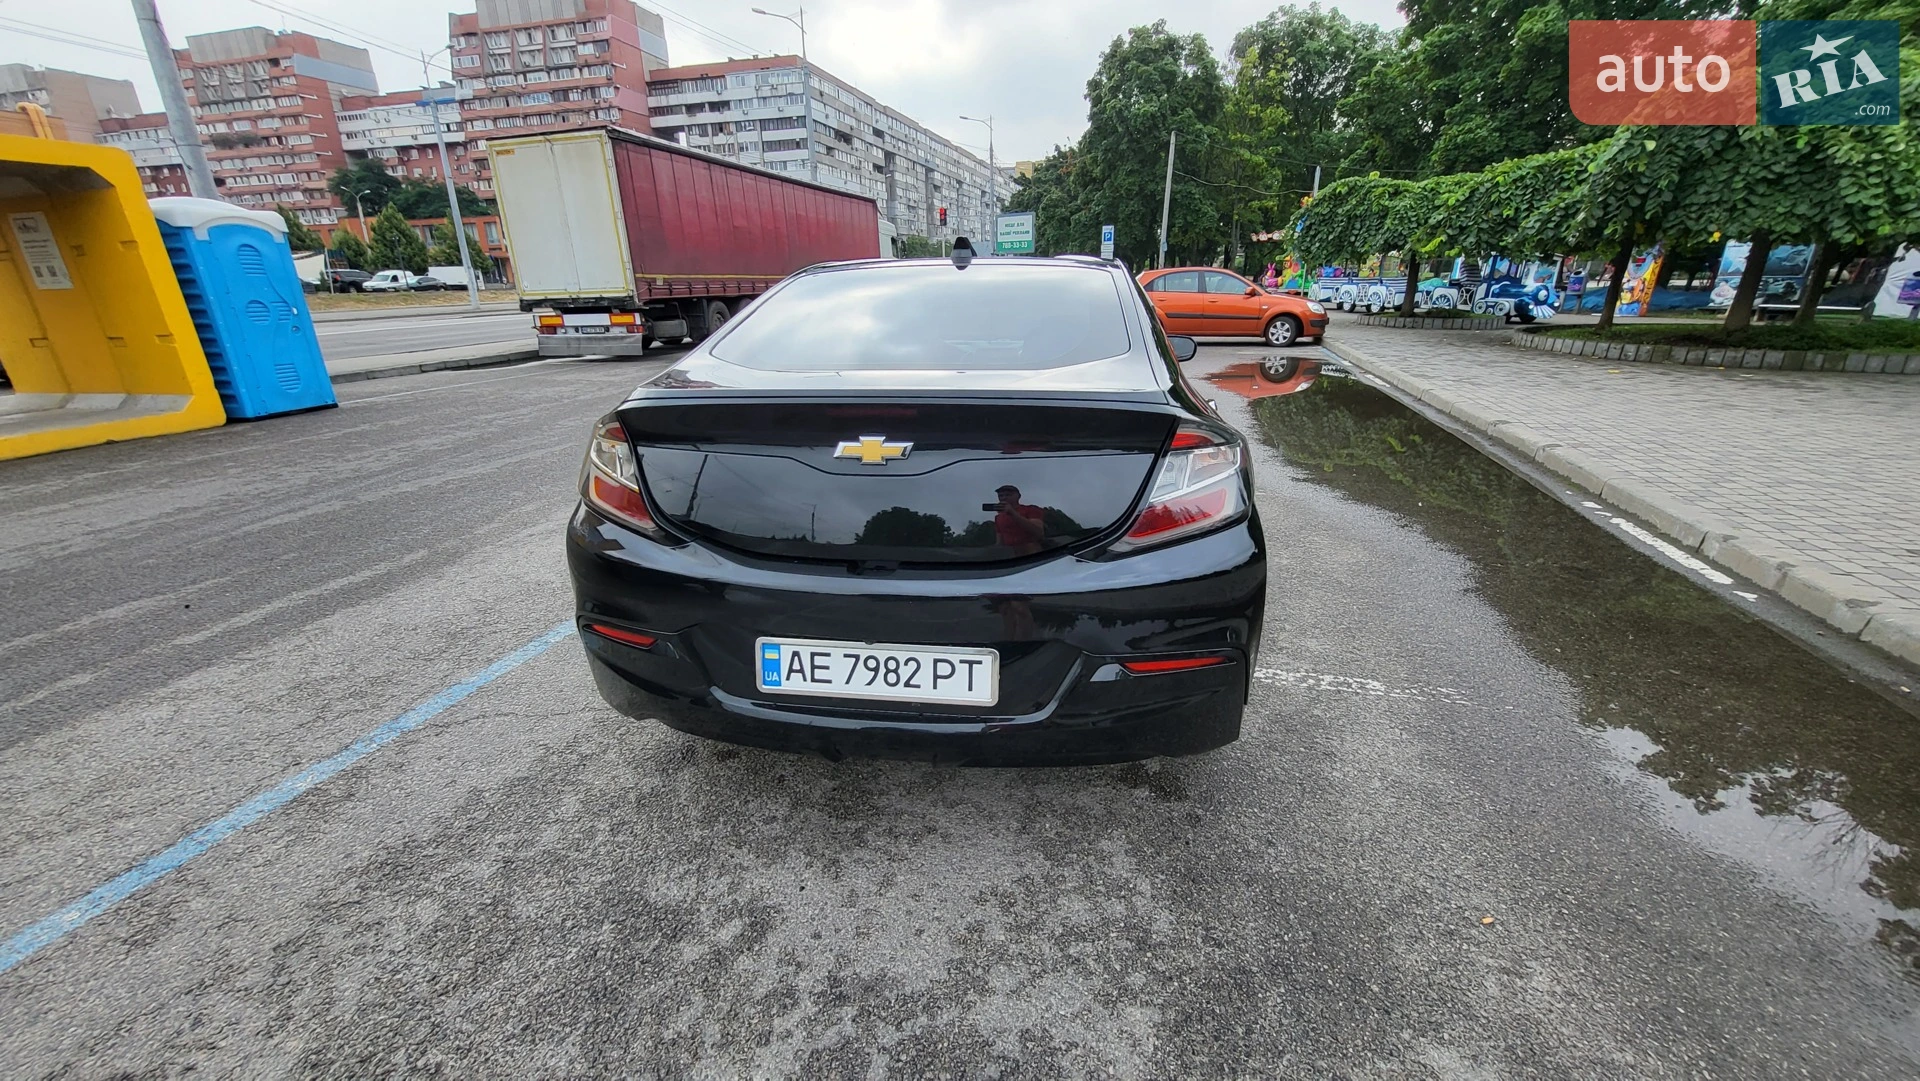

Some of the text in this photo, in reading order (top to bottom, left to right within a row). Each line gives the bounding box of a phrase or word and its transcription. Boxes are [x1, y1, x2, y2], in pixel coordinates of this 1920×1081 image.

[765, 650, 983, 692] UA AE 7982 PT
